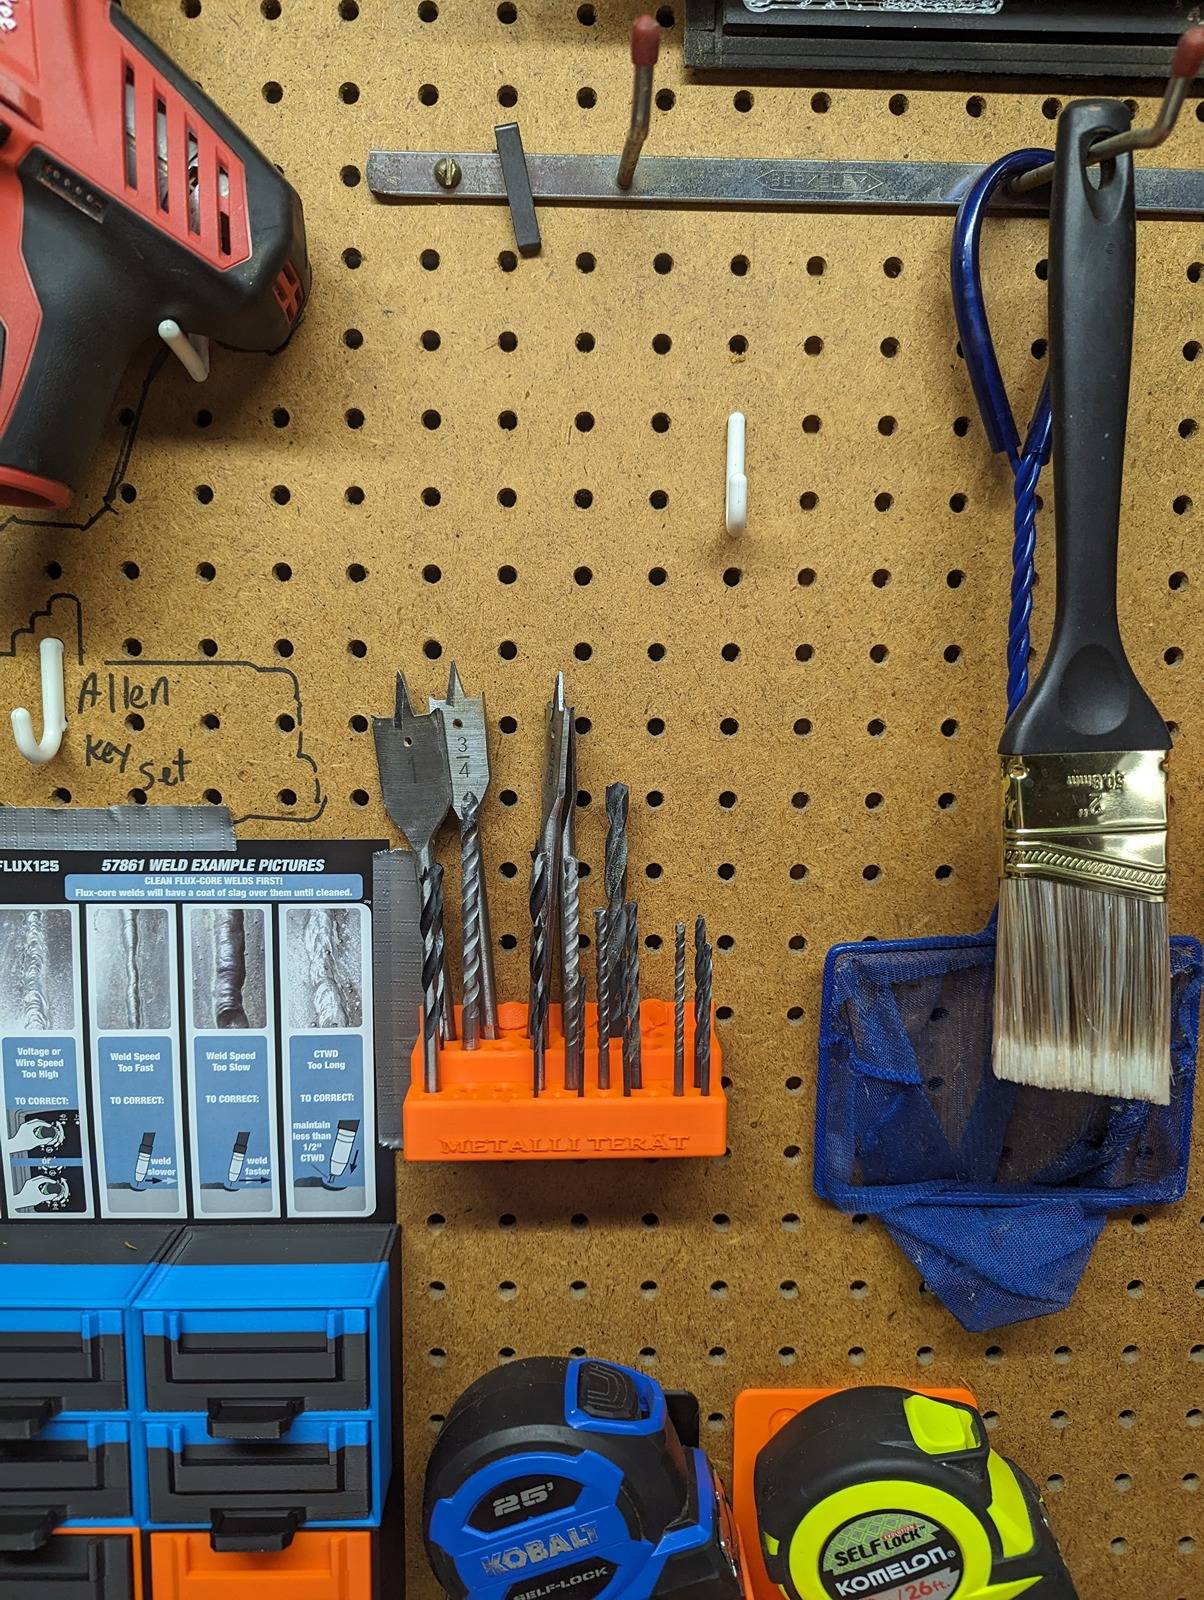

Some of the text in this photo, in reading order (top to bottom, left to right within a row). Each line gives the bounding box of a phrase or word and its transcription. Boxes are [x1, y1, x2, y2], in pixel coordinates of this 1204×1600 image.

[77, 672, 169, 714] Allen
[101, 859, 325, 872] 57861 WELD EXAMPLE PICTURES
[144, 877, 283, 885] CLEAN FLUX-CORE WELDS FIRST!
[75, 889, 116, 897] Flux-core
[119, 889, 144, 897] welds
[147, 889, 163, 897] will
[165, 889, 187, 897] have
[217, 888, 226, 896] of
[228, 888, 247, 898] slag
[270, 888, 292, 896] them
[294, 888, 314, 896] until
[316, 888, 352, 896] cleaned.
[17, 1048, 49, 1057] Voltage
[110, 1052, 161, 1062] Weld Speed
[206, 1052, 256, 1061] Weld Speed
[313, 1050, 338, 1058] CTWD
[15, 1059, 64, 1068] Wire Speed
[118, 1064, 153, 1072] Too Fast
[212, 1063, 250, 1072] Too Slow
[307, 1061, 346, 1071] Too Long
[22, 1070, 58, 1080] Too High
[15, 1097, 69, 1105] TO CORRECT:
[110, 1096, 165, 1105] TO CORRECT:
[205, 1095, 260, 1103] TO CORRECT:
[300, 1093, 354, 1102] TO CORRECT:
[293, 1121, 330, 1129] maintain
[312, 1132, 331, 1140] than
[439, 1135, 690, 1155] METALLI TERÄT
[300, 1154, 325, 1162] CTWD
[148, 1168, 176, 1176] slower
[245, 1168, 270, 1176] faster
[480, 1520, 600, 1576] KOBALT
[834, 1538, 881, 1566] SELF
[512, 1567, 609, 1600] SELF-LOCK
